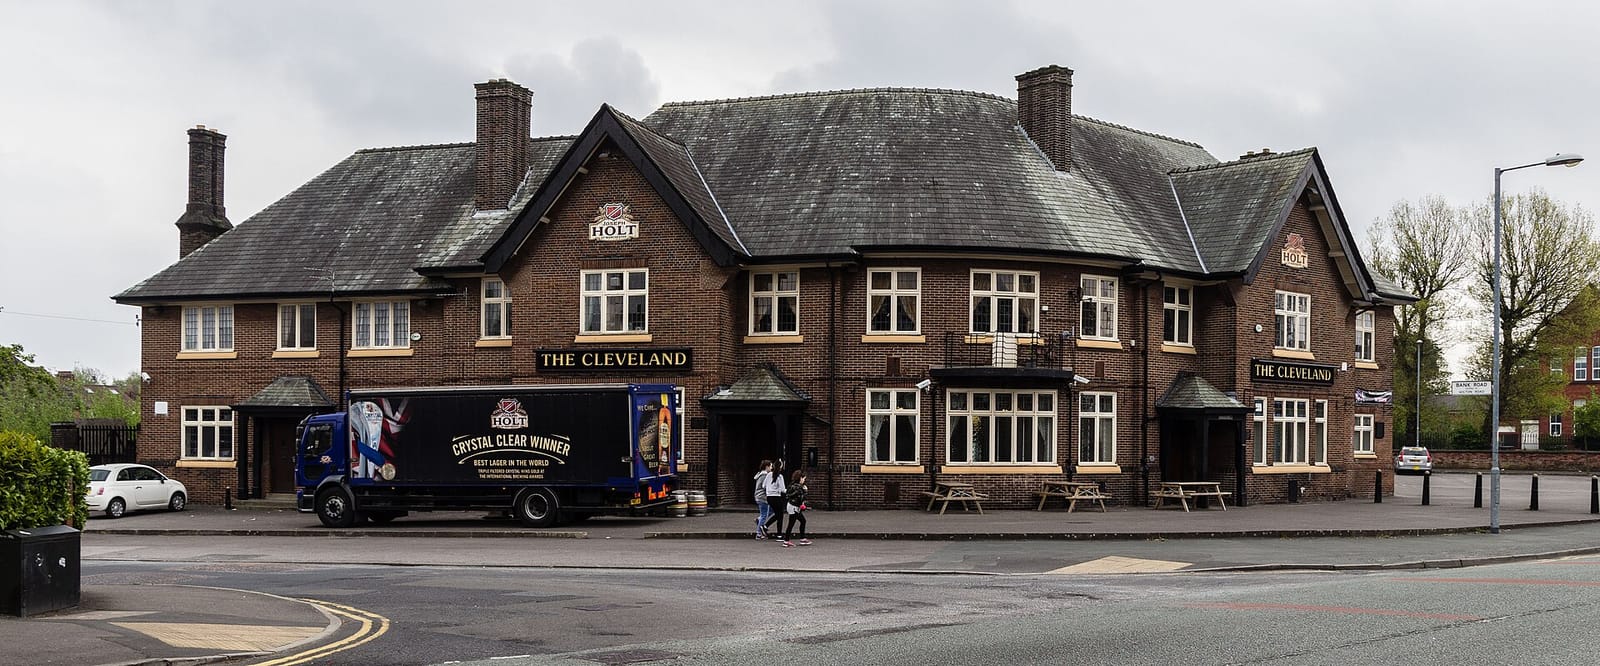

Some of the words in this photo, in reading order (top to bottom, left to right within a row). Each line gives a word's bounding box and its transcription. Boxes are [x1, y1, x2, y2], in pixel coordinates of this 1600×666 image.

[592, 225, 636, 236] HOLT
[1283, 252, 1306, 264] HOLT
[541, 353, 575, 366] THE
[582, 352, 687, 366] CLEVELAND
[1255, 364, 1275, 377] THE
[1277, 365, 1332, 381] CLEVELAND
[493, 417, 526, 426] HOLT
[452, 436, 494, 456] CRYSTAL
[496, 434, 527, 447] CLEAR
[530, 435, 571, 457] WINNER
[473, 459, 488, 467] BEST
[489, 459, 507, 467] LAGER
[508, 459, 515, 467] IN
[516, 459, 527, 467] THE
[528, 459, 549, 467] WORLD
